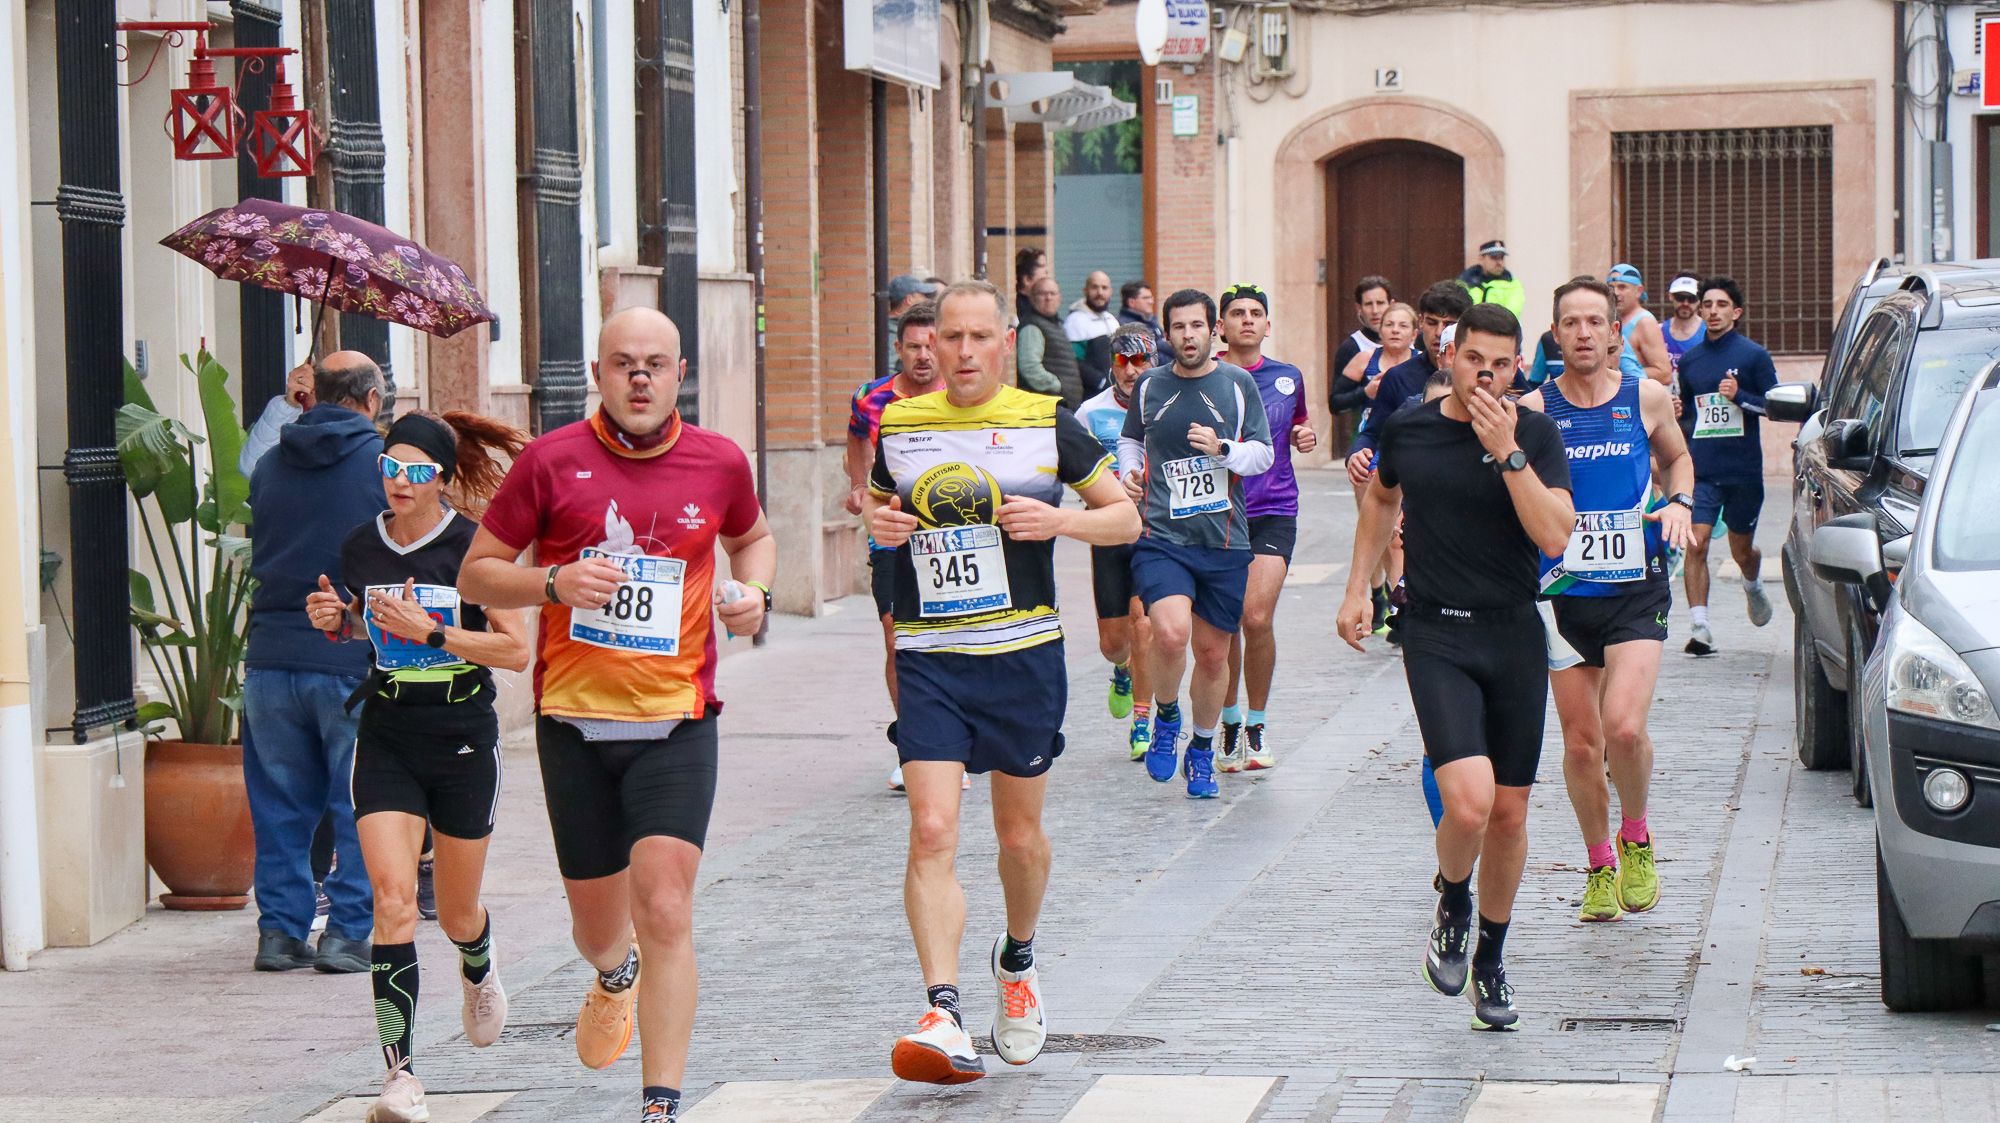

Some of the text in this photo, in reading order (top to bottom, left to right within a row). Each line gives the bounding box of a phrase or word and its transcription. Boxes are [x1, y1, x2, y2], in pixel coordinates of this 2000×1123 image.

[1375, 68, 1398, 88] 12
[1704, 406, 1730, 424] 265
[1565, 441, 1631, 461] nerplus
[1170, 460, 1192, 477] 21K
[914, 464, 961, 505] CLUB ATLETISMO
[1177, 473, 1215, 499] 728
[1575, 513, 1600, 532] 21K
[919, 531, 947, 555] 21K
[1581, 533, 1626, 561] 210
[929, 553, 980, 589] 345
[1441, 607, 1471, 618] KIPRUN
